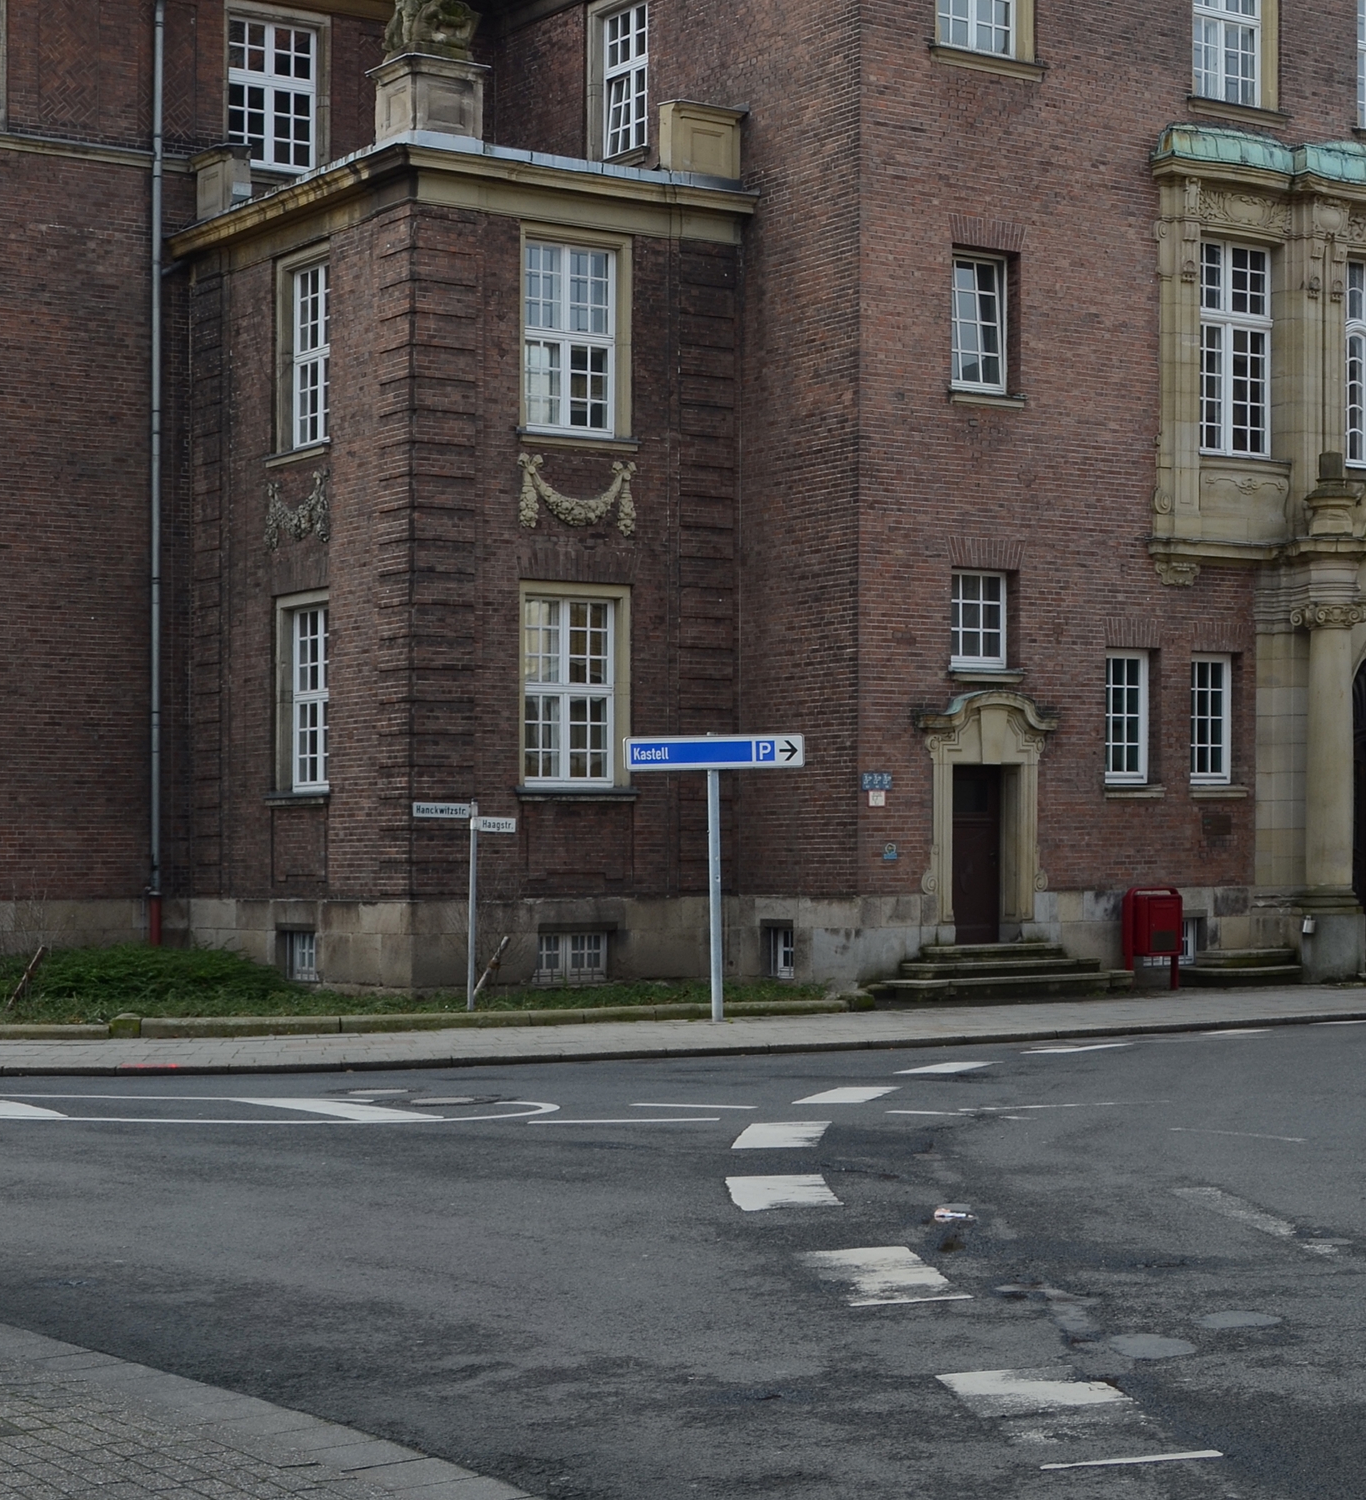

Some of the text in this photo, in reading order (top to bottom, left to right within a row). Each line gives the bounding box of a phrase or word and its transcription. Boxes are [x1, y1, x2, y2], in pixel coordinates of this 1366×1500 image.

[633, 742, 771, 761] Kastell P
[416, 805, 467, 816] Hanckwitzstr.
[482, 819, 514, 831] Haagstr.
